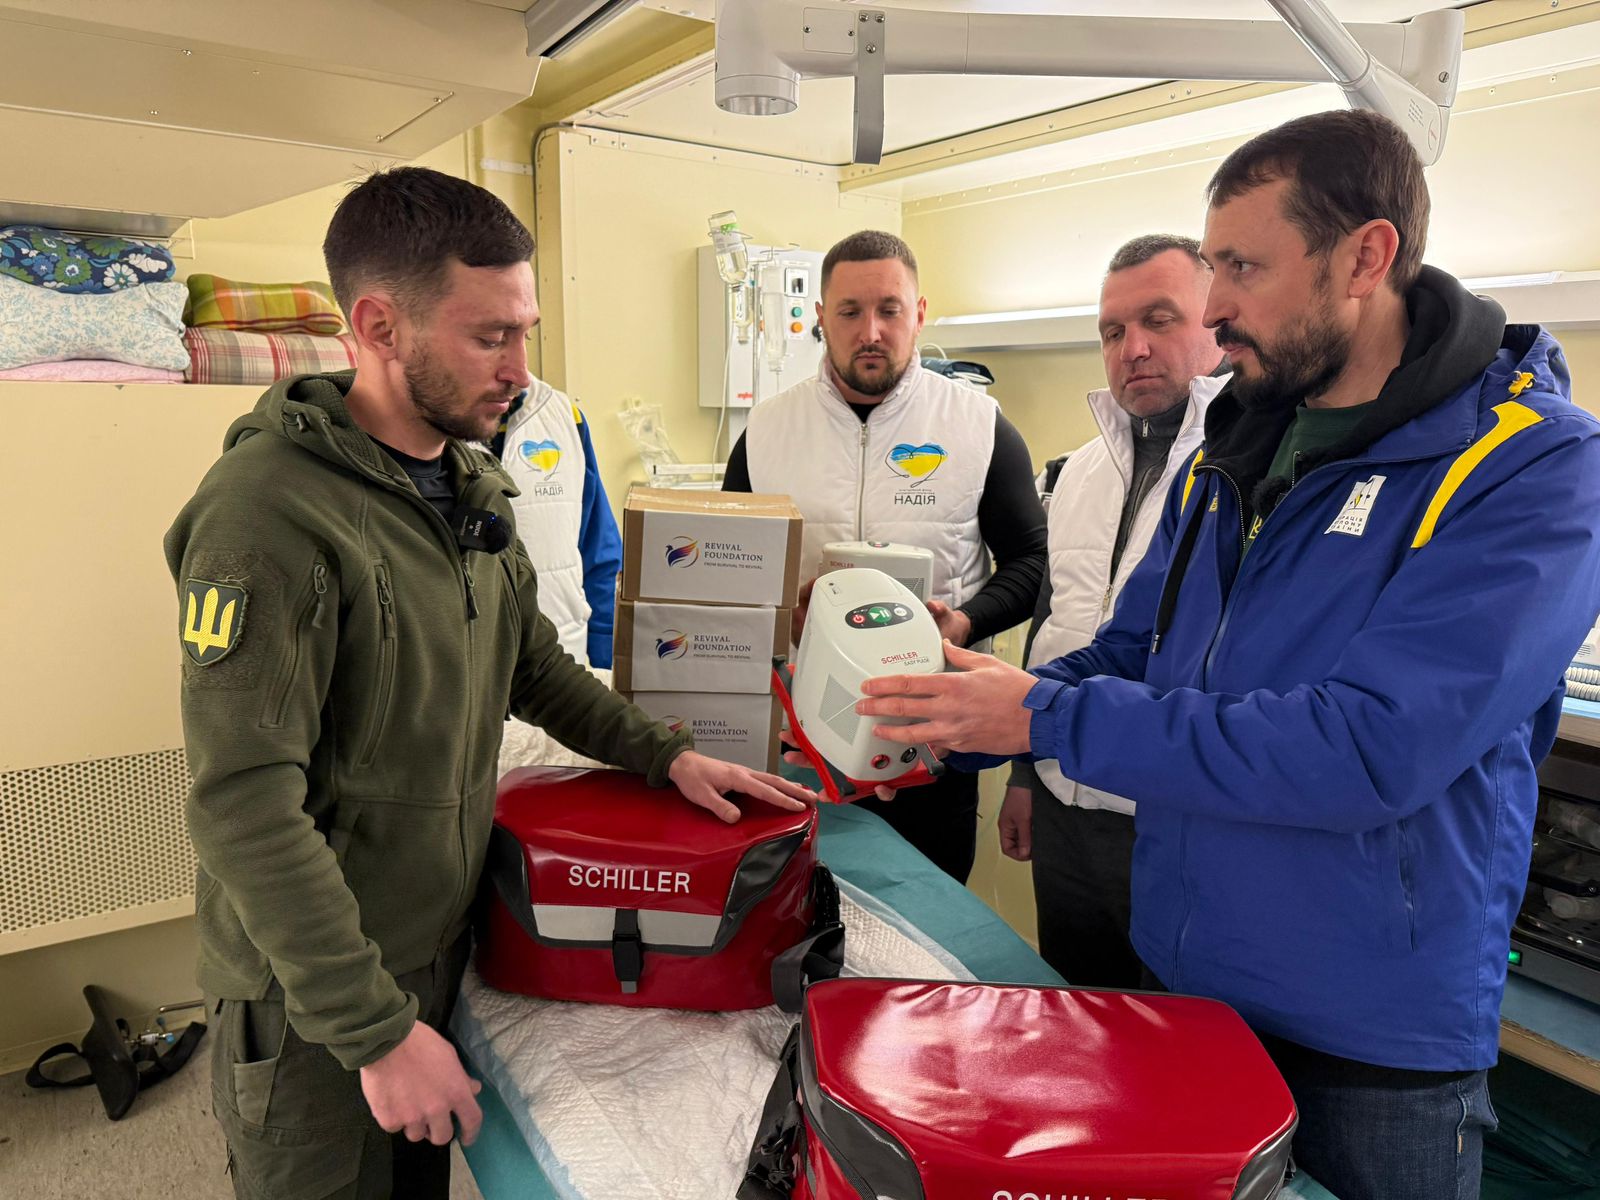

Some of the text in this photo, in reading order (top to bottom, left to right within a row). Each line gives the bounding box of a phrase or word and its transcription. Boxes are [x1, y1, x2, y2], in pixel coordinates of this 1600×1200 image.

[894, 495, 936, 506] НАДІЯ
[704, 542, 742, 552] REVIVAL
[704, 551, 763, 562] FOUNDATION
[694, 634, 731, 643] REVIVAL
[693, 643, 752, 652] FOUNDATION
[881, 651, 918, 665] SCHILLER
[692, 719, 728, 727] REVIVAL
[692, 728, 748, 736] FOUNDATION
[568, 864, 690, 894] SCHILLER
